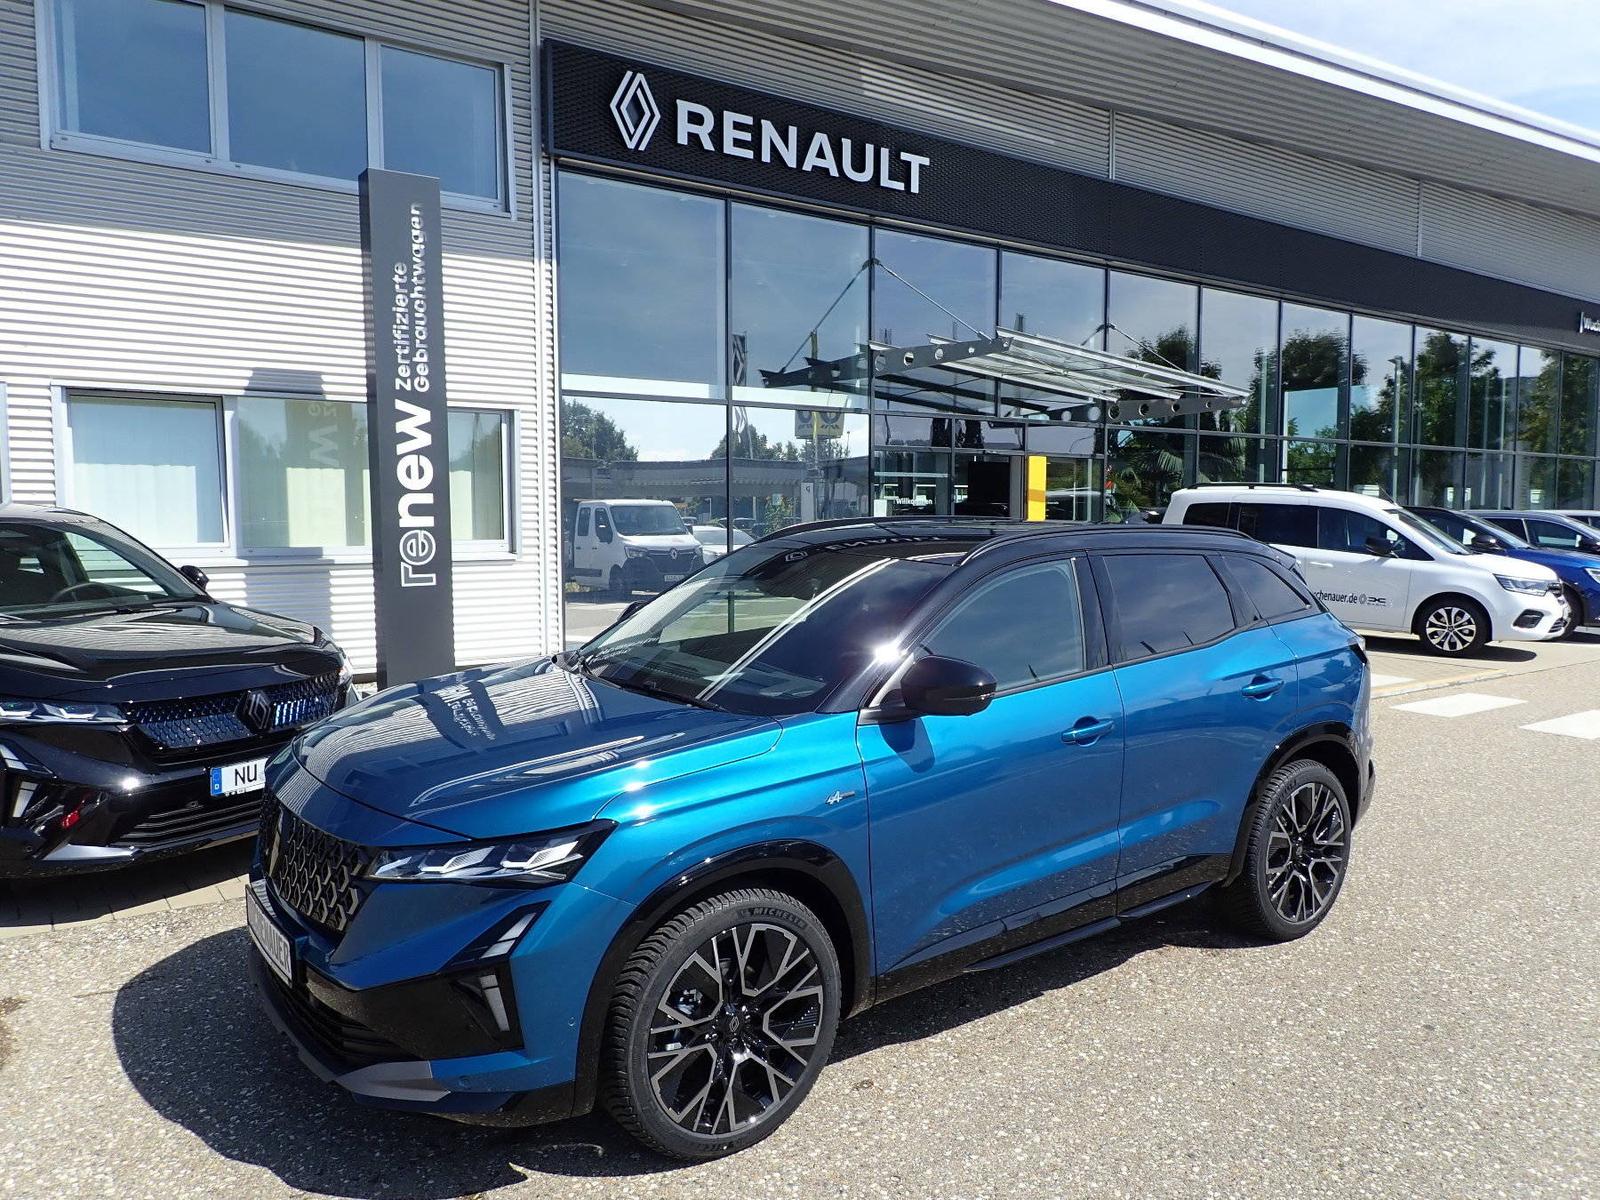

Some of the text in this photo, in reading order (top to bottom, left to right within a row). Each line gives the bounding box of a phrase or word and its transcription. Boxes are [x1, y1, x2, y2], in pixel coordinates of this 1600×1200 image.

[676, 99, 930, 193] RENAULT
[392, 262, 412, 392] Zertifizierte
[410, 202, 430, 393] Gebrauchtwagen
[395, 399, 436, 587] renew
[235, 764, 257, 786] NU
